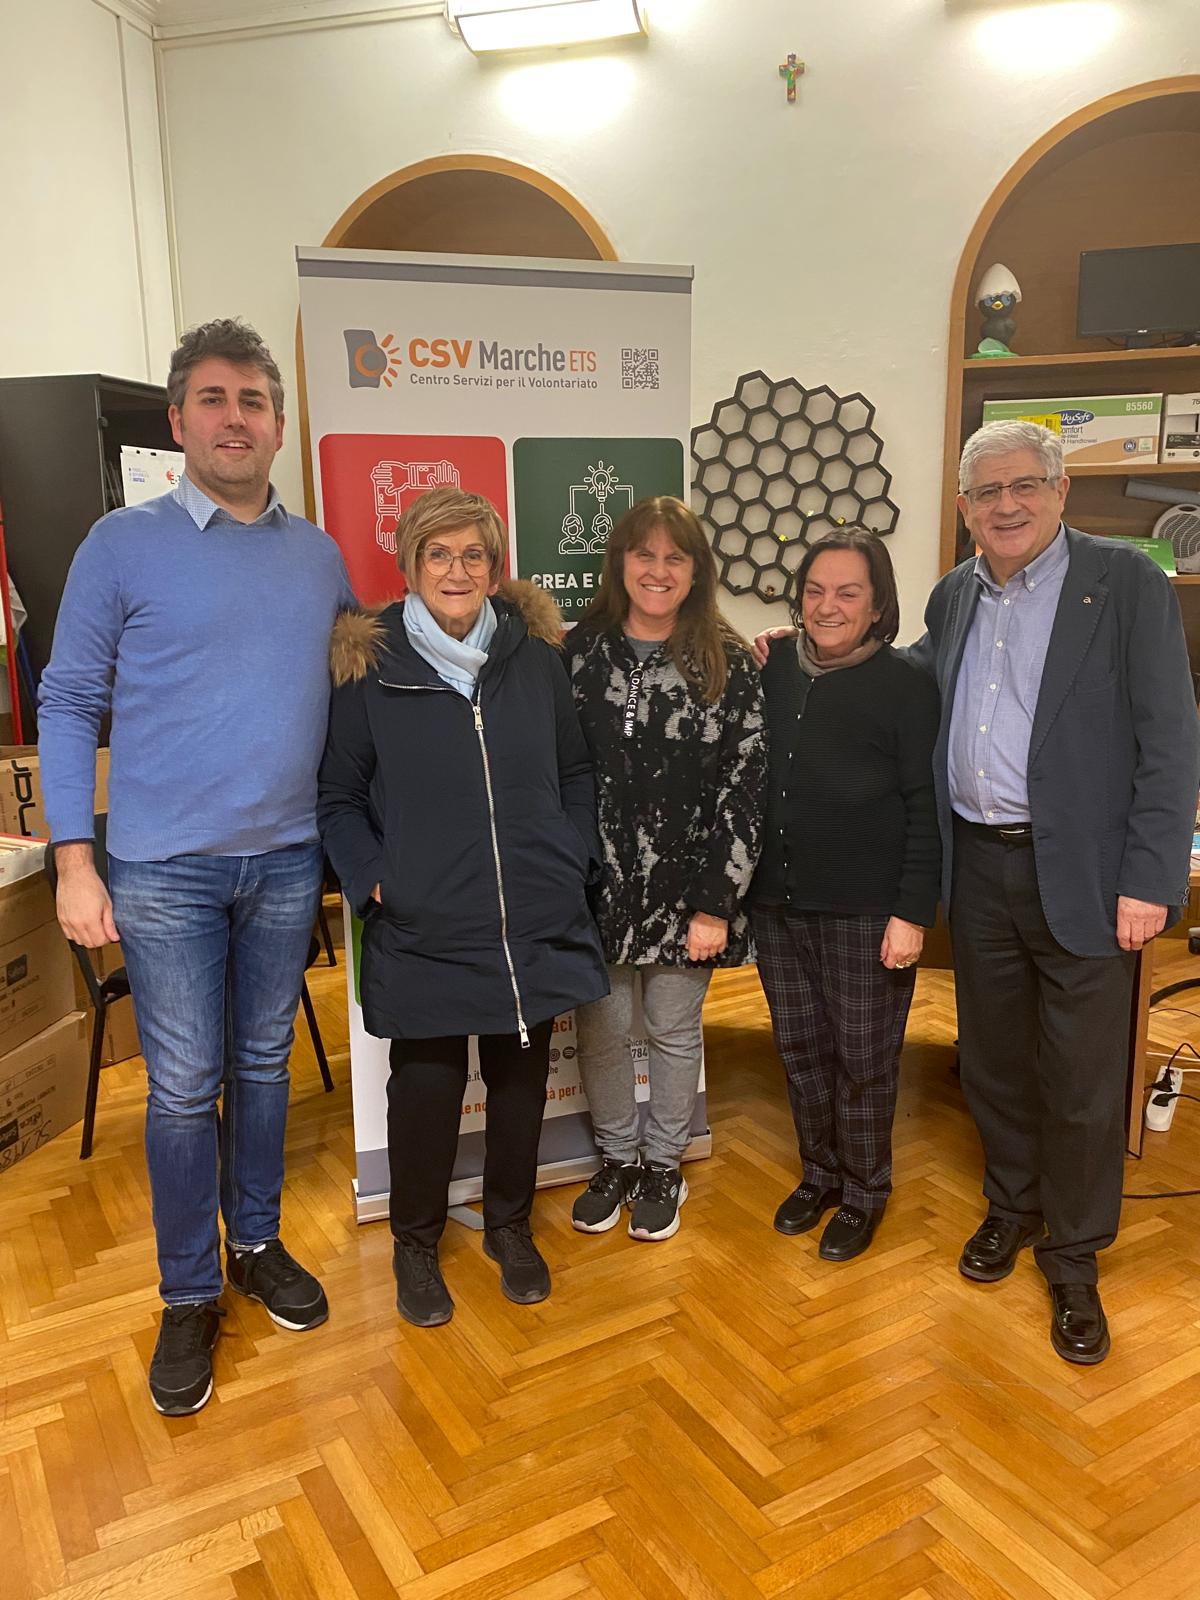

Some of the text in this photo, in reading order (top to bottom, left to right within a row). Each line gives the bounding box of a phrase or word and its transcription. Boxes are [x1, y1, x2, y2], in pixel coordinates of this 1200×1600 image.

[408, 338, 597, 373] CSV Marche ETS
[410, 373, 598, 390] Centro Servizi per il Volontariato
[1125, 401, 1153, 412] 85560
[530, 573, 579, 589] CREA
[582, 572, 594, 588] E
[623, 678, 641, 737] DANCE & IMP
[558, 1085, 577, 1101] per
